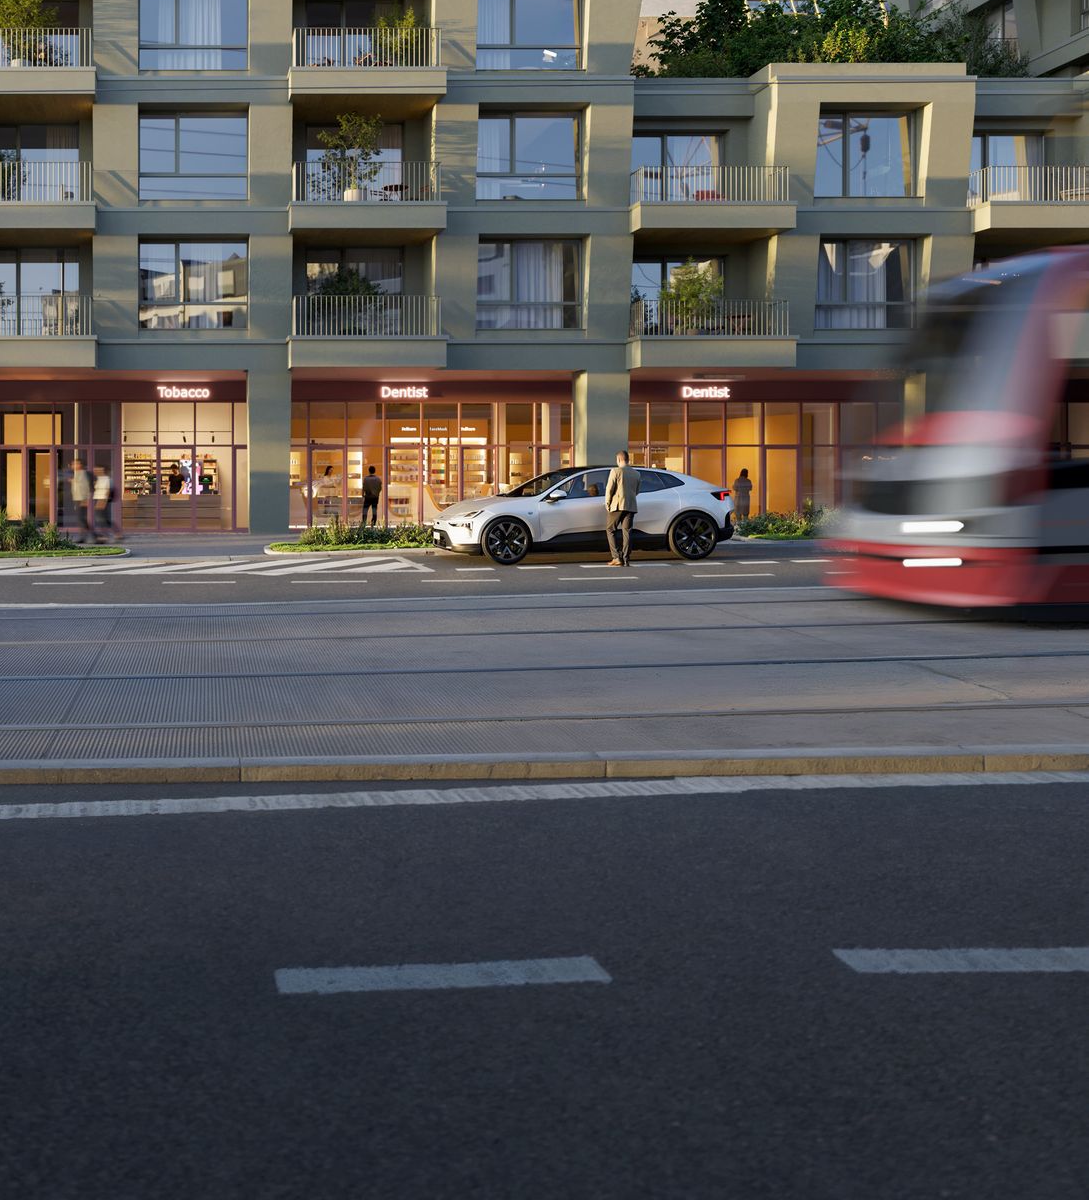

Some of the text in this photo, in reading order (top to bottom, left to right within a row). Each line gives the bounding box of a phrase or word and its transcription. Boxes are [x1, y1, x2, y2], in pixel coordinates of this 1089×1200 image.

[157, 386, 210, 398] Tobacco
[381, 386, 428, 398] Dentist
[682, 386, 730, 398] Dentist
